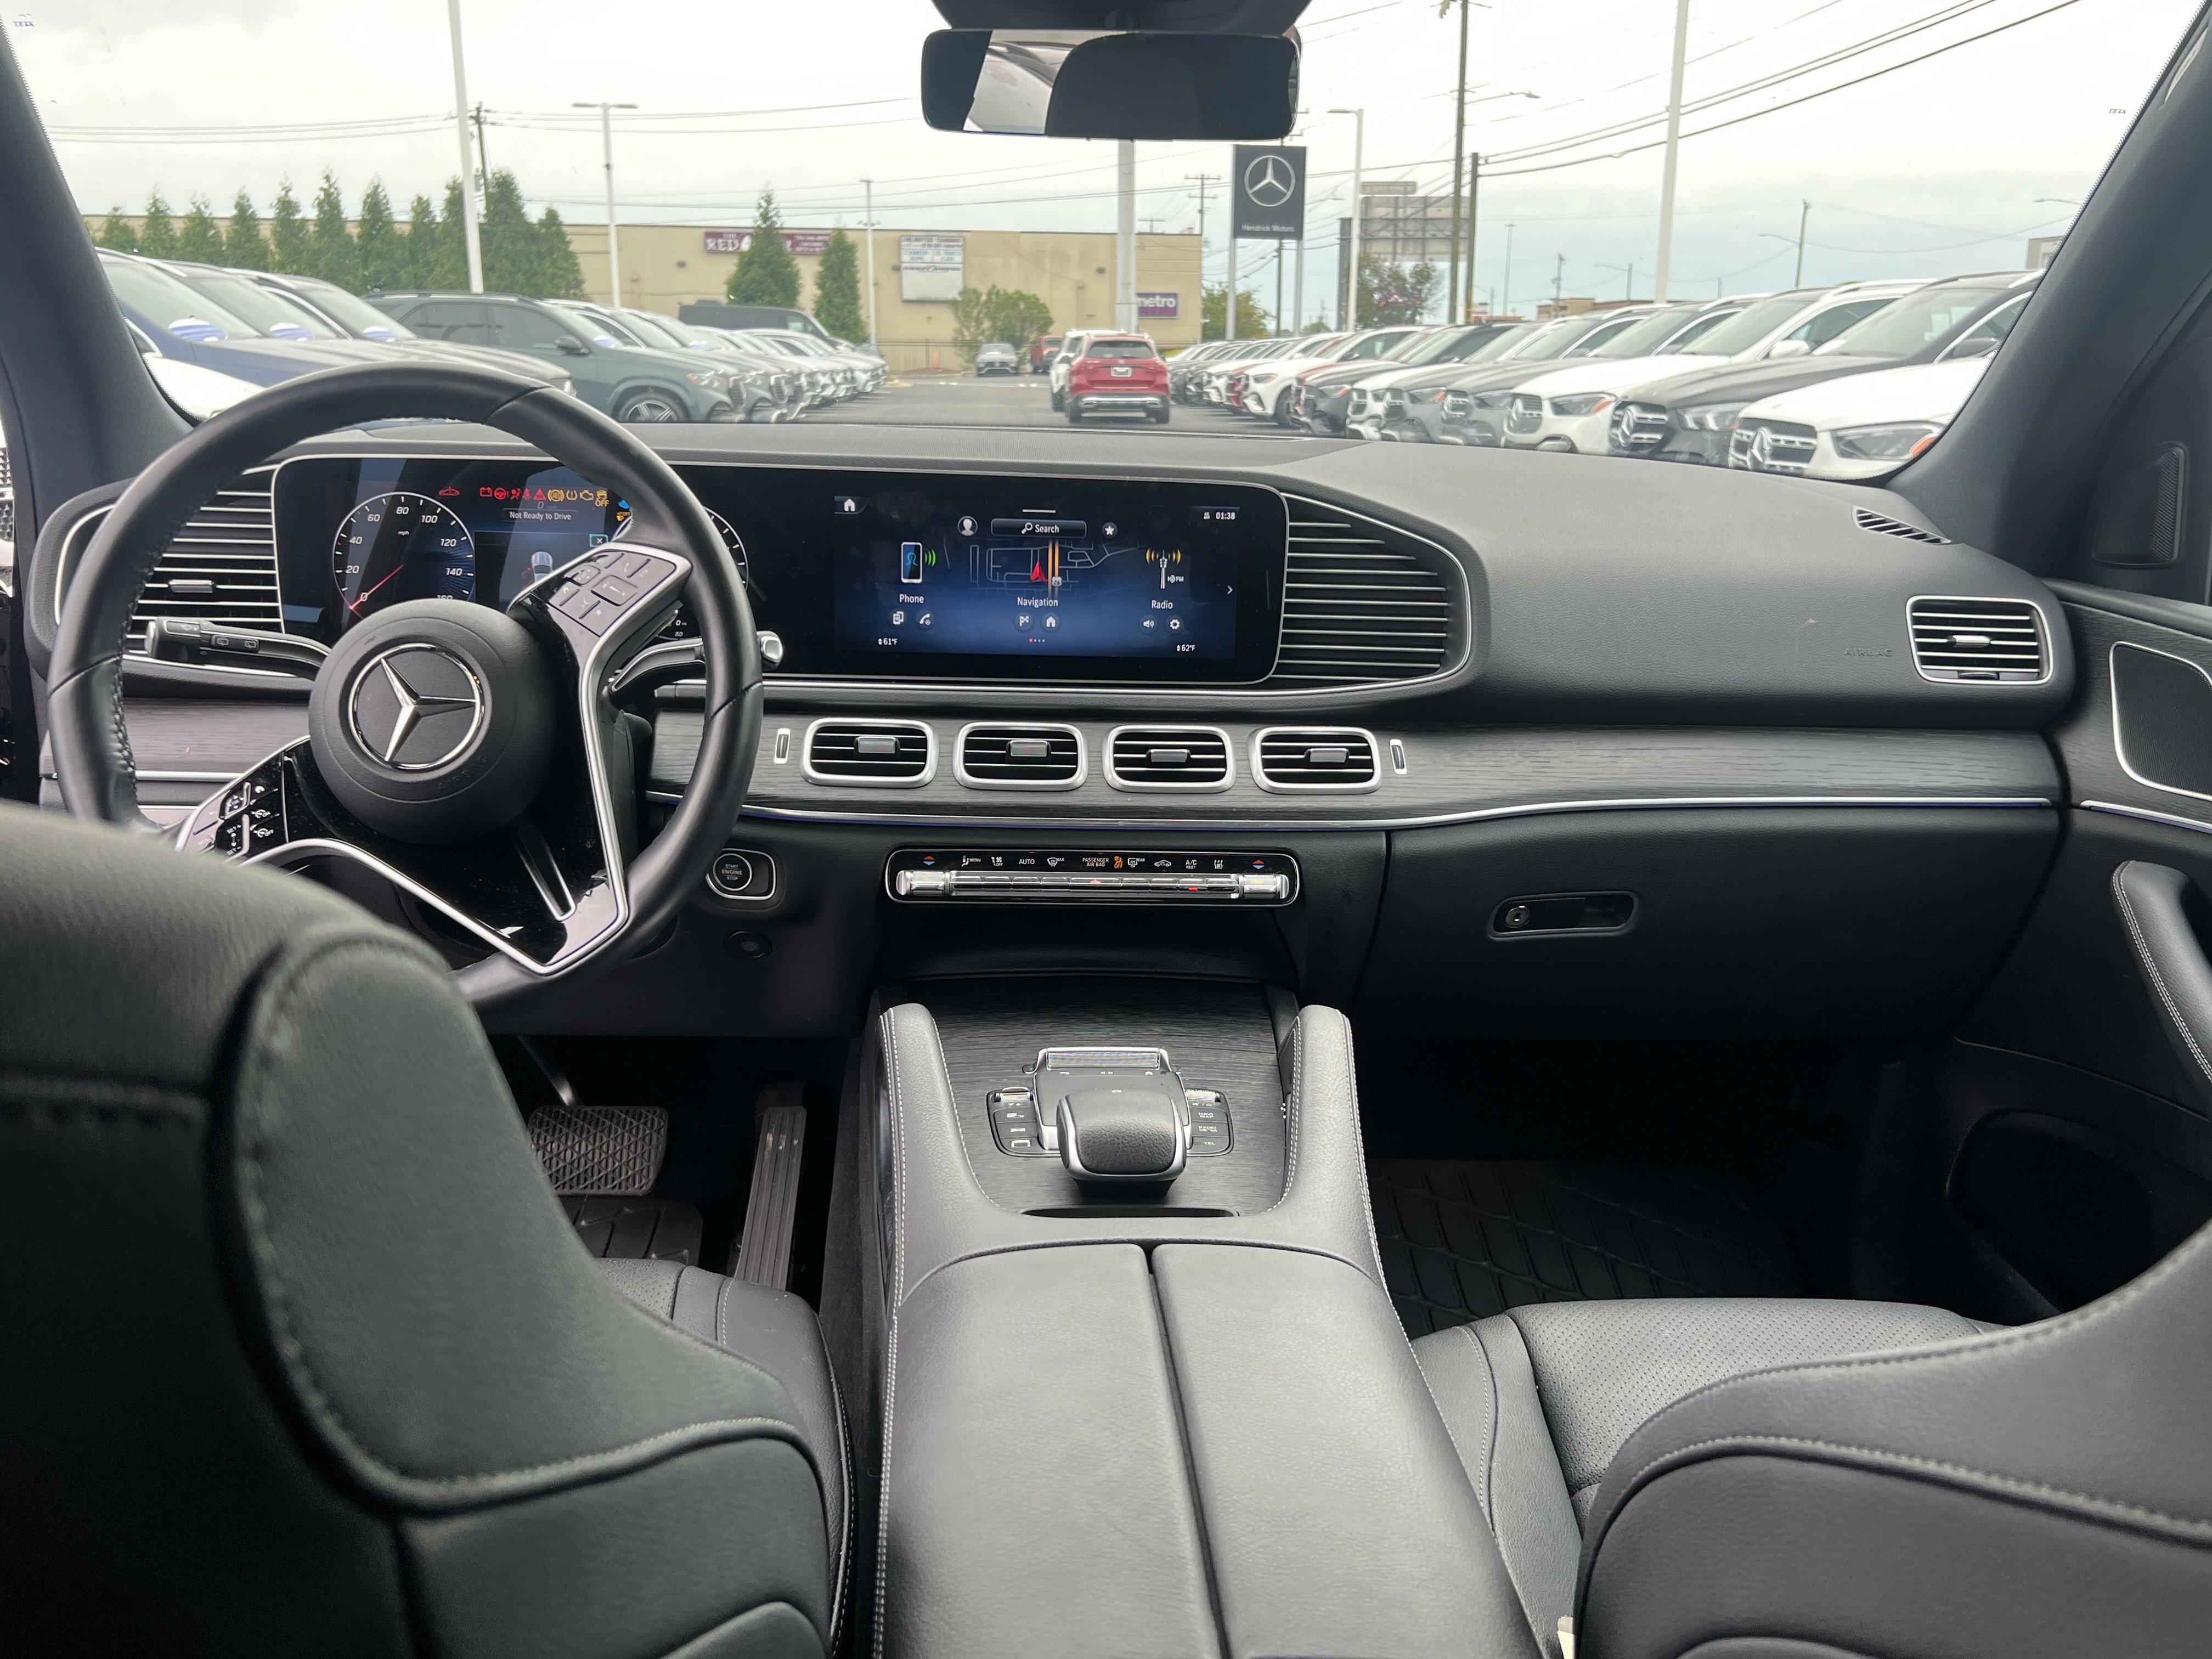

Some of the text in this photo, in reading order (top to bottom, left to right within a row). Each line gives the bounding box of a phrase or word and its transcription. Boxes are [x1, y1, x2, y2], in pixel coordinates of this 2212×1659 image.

[706, 238, 740, 251] RED
[396, 506, 409, 515] 80
[368, 514, 381, 522] 60
[421, 515, 438, 523] 100
[523, 511, 543, 521] Ready
[1215, 511, 1235, 520] 01:38
[1035, 524, 1060, 533] Search
[349, 536, 363, 544] 40
[441, 538, 457, 547] 120
[346, 565, 359, 574] 20
[446, 568, 463, 576] 140
[360, 592, 368, 602] 0
[899, 594, 924, 603] Phone
[1017, 597, 1059, 608] Navigation
[1151, 600, 1173, 610] Radio
[1844, 648, 1893, 657] AIRBAG
